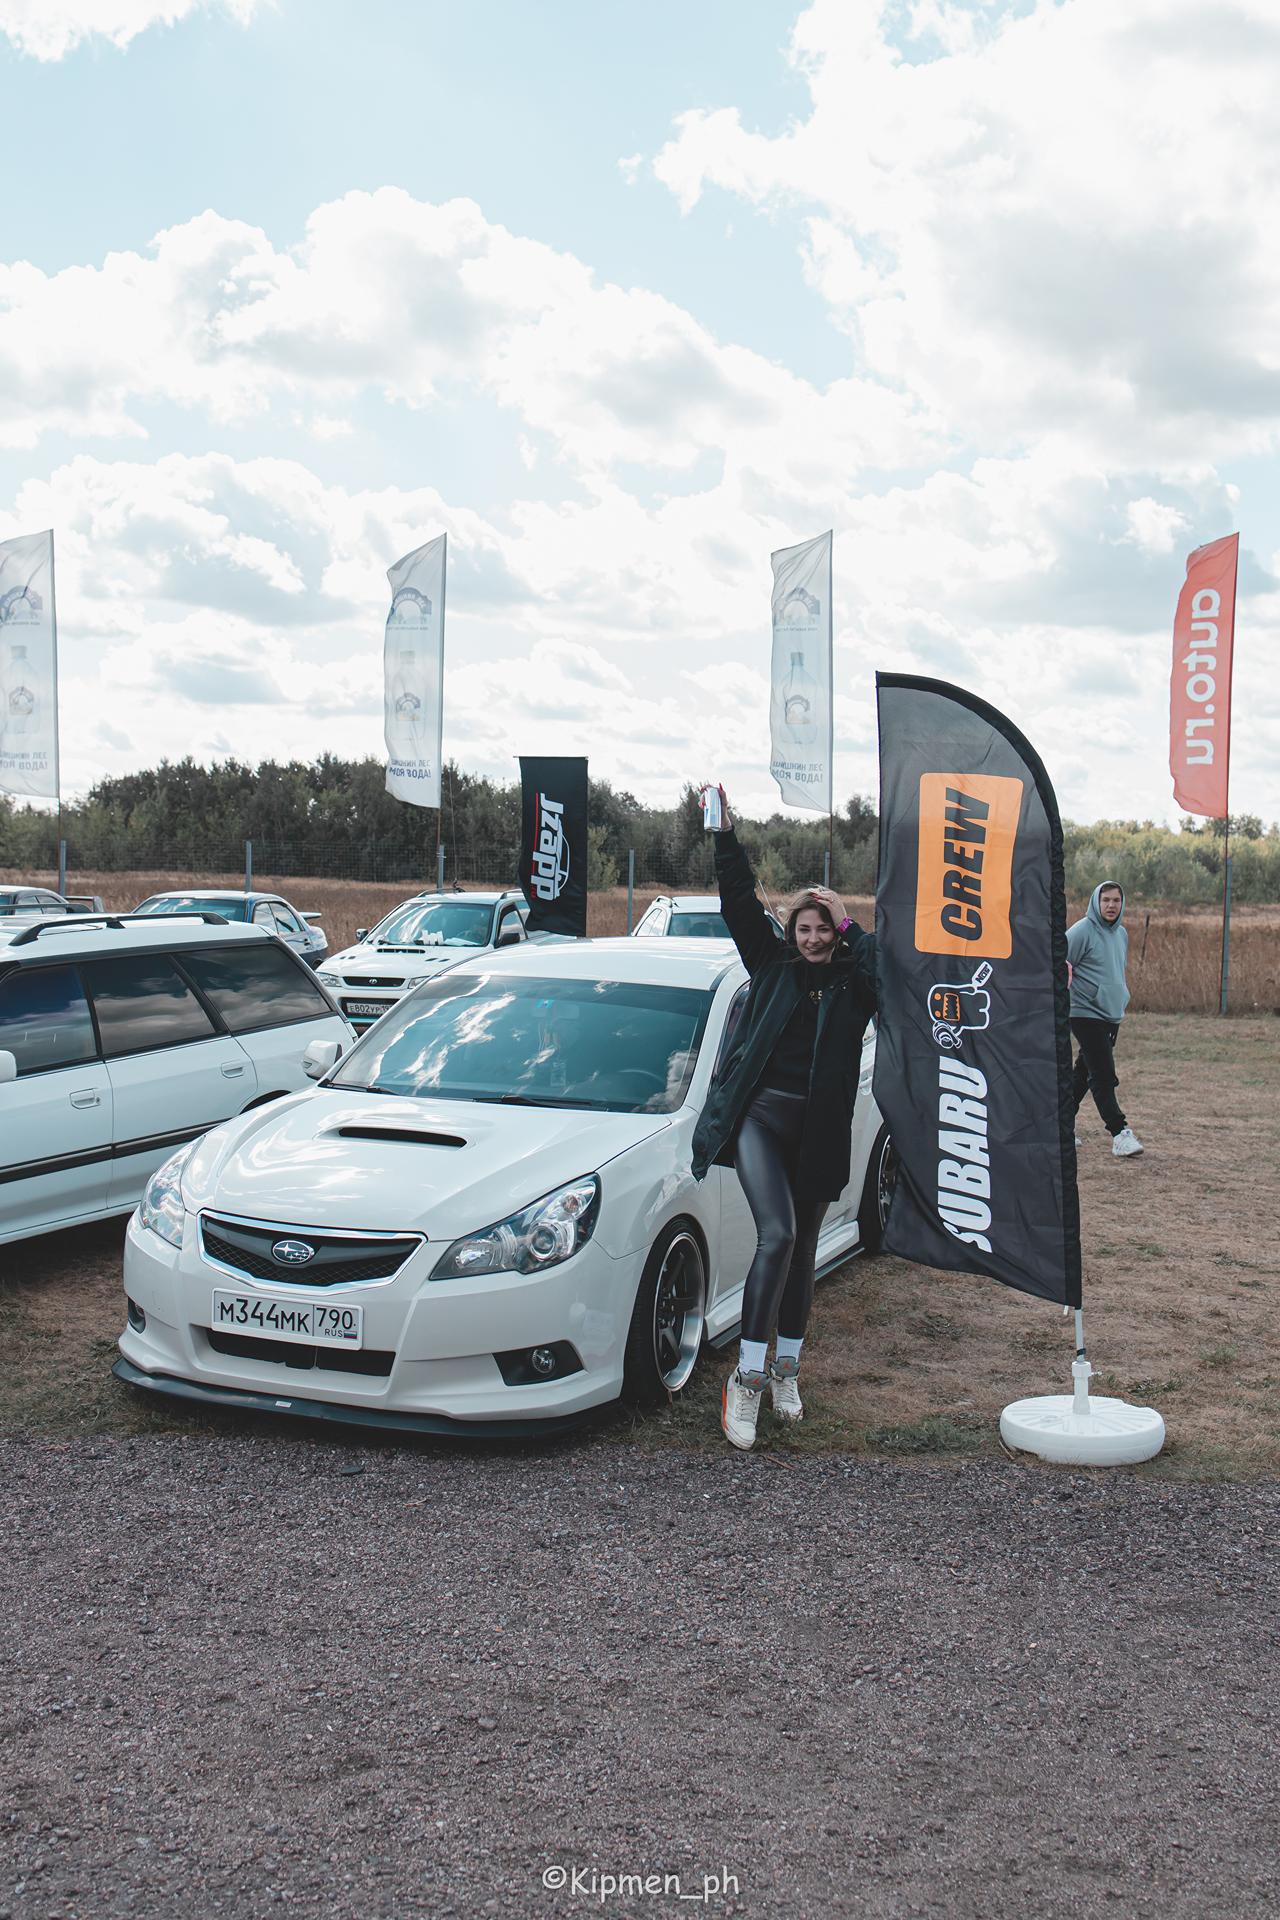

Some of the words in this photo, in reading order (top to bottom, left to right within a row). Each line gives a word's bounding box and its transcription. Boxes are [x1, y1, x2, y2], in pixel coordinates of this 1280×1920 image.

[389, 766, 405, 777] МОЯ
[406, 768, 432, 780] ВОДА!
[794, 772, 823, 785] ВОДА!
[941, 786, 990, 941] CREW
[937, 1055, 993, 1254] SUBARU
[316, 1307, 353, 1330] 790
[324, 1328, 343, 1338] RUS
